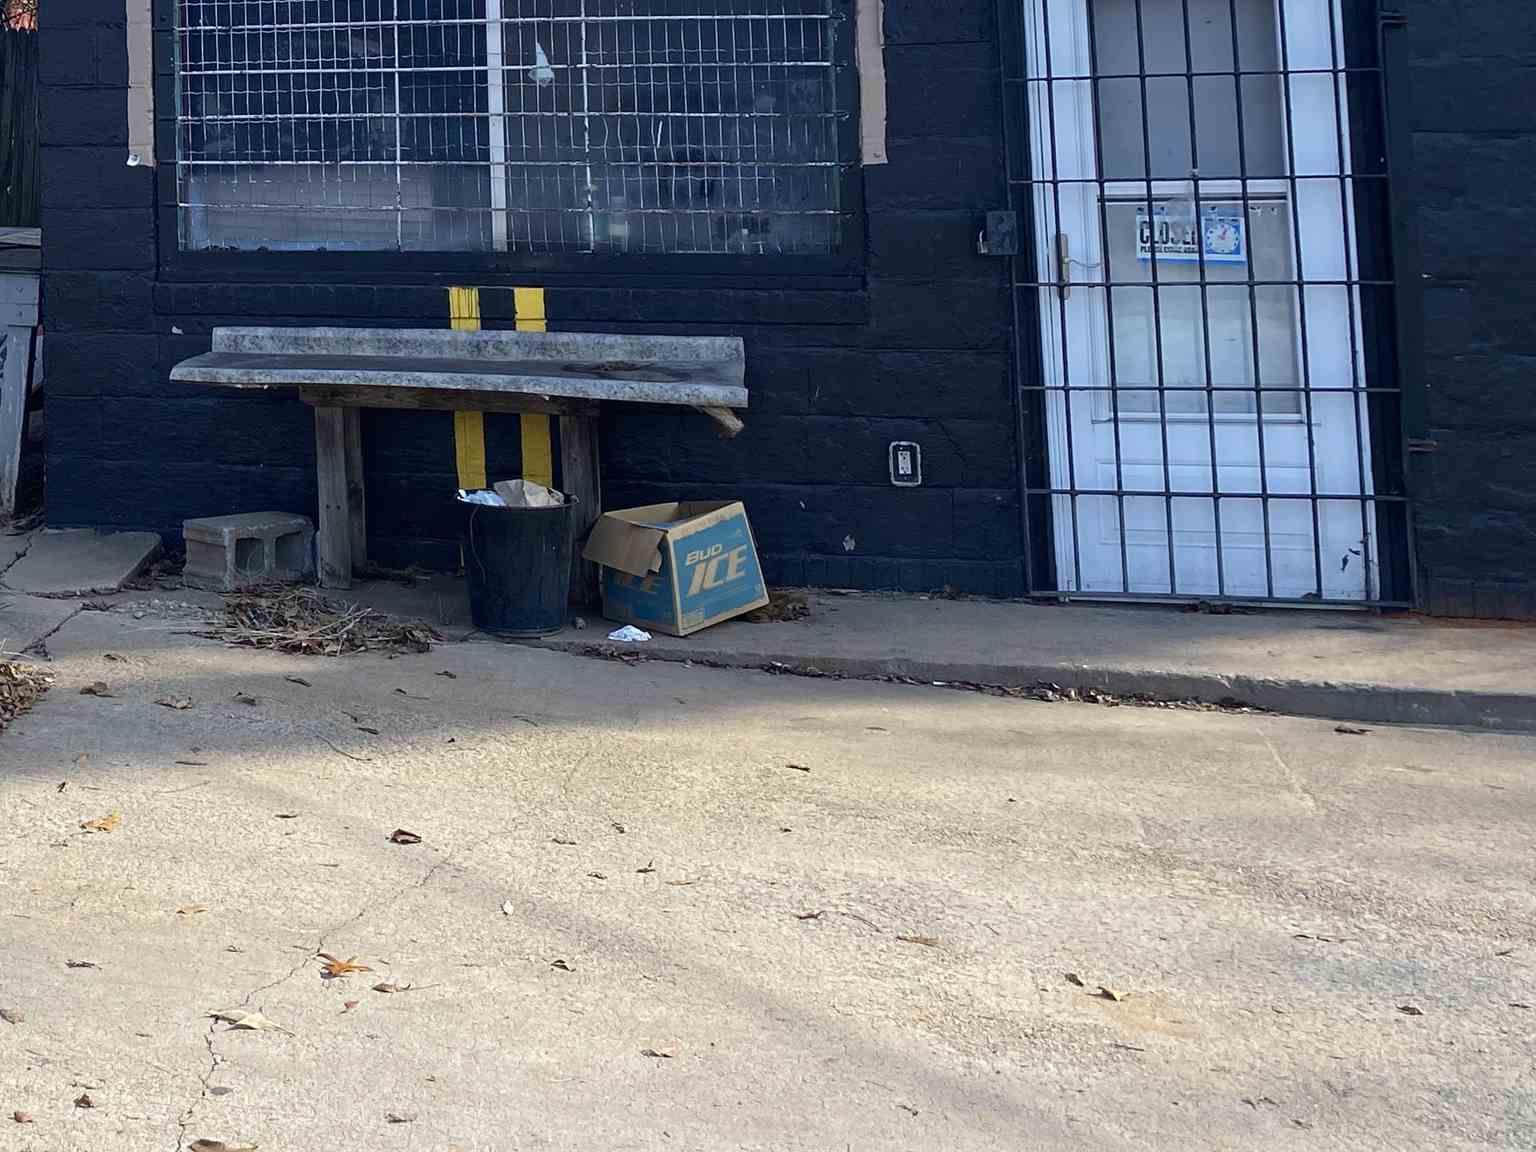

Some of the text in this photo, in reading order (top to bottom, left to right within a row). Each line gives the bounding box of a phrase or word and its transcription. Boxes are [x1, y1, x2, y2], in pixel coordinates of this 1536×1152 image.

[1140, 221, 1198, 245] CLOE
[685, 543, 724, 565] BUD
[687, 544, 748, 597] ICE
